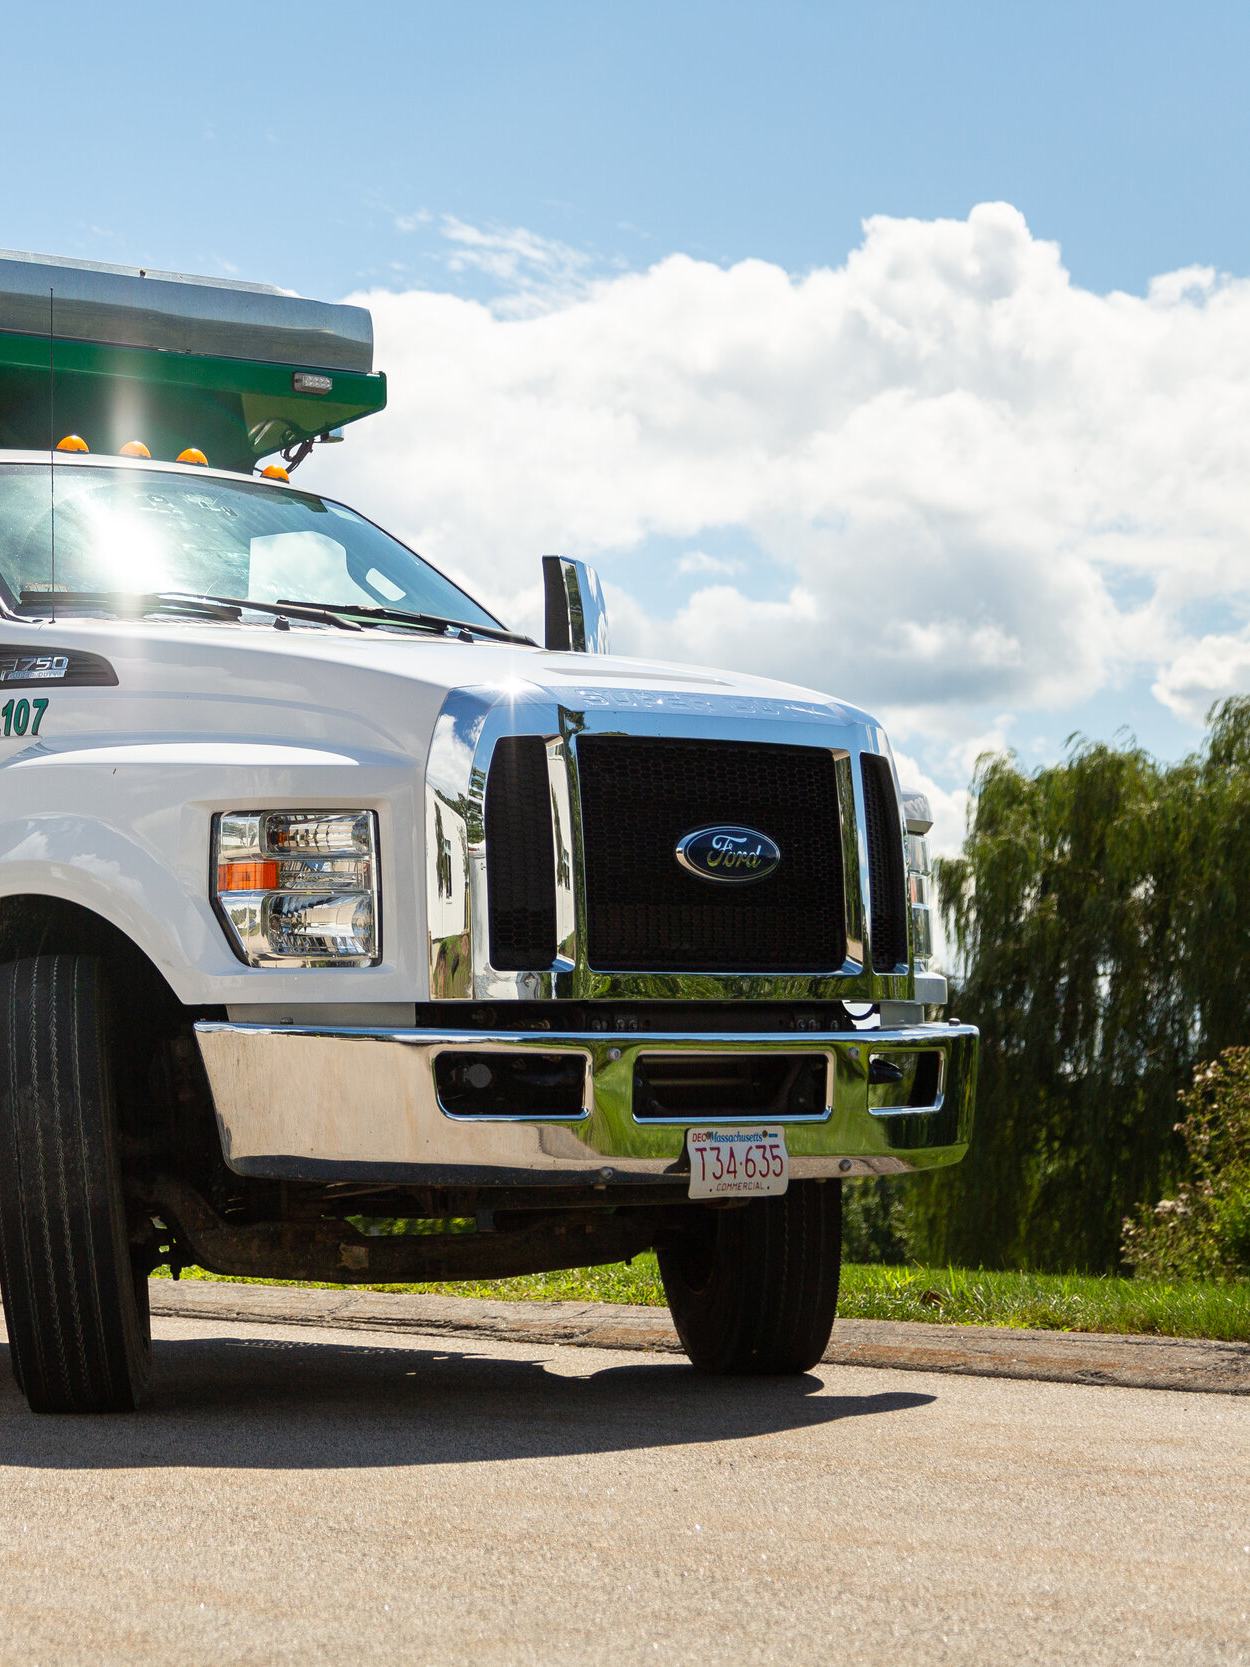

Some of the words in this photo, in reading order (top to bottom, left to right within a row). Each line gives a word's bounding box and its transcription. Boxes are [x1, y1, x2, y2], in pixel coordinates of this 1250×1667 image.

[707, 835, 762, 868] Ford
[692, 1133, 707, 1143] DEC
[710, 1131, 763, 1143] Massachusetts
[716, 1182, 764, 1192] COMMERCIAL
